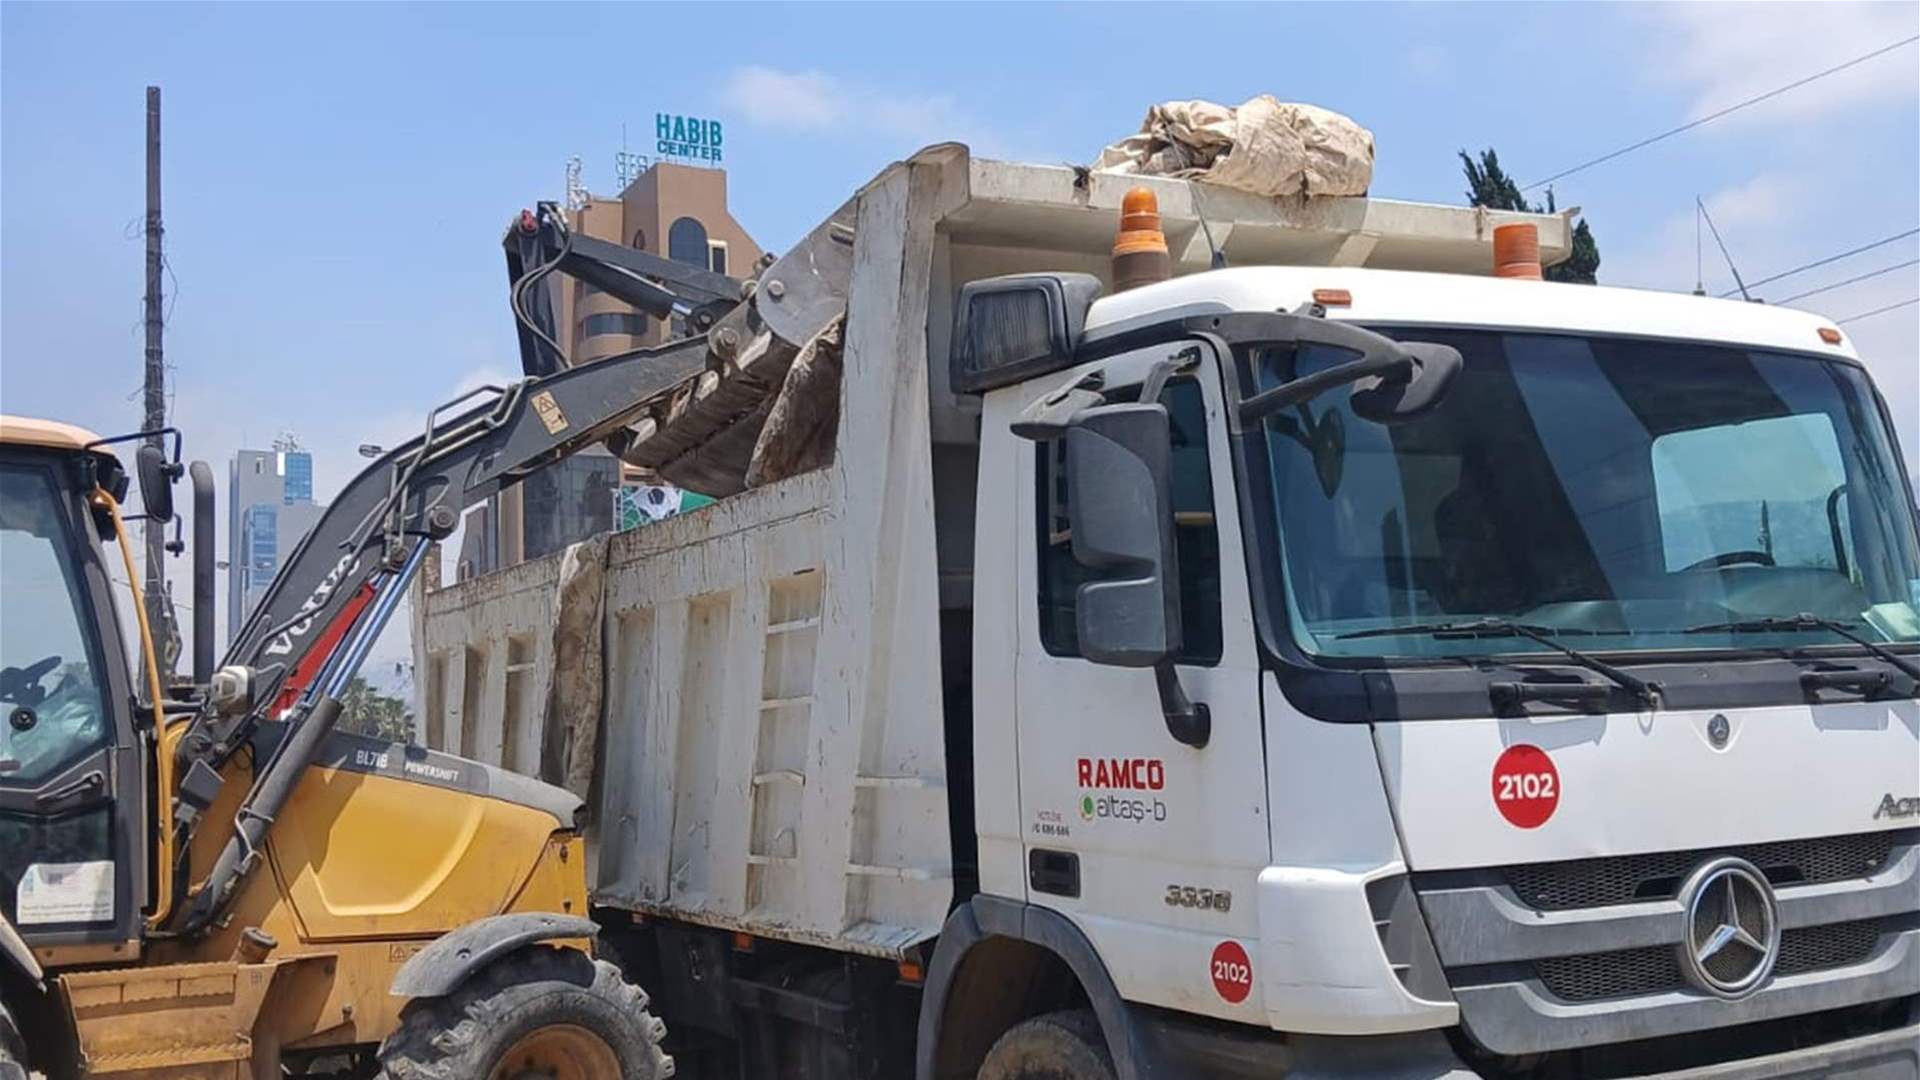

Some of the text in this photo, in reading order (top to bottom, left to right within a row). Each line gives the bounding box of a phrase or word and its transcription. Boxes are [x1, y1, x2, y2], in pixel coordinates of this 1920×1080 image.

[656, 113, 722, 146] HABIB
[657, 140, 722, 161] CENTER
[404, 761, 459, 781] POWERSHIFT
[1077, 758, 1164, 790] RAMCO
[1499, 772, 1555, 800] 2102
[1214, 961, 1249, 984] 2102
